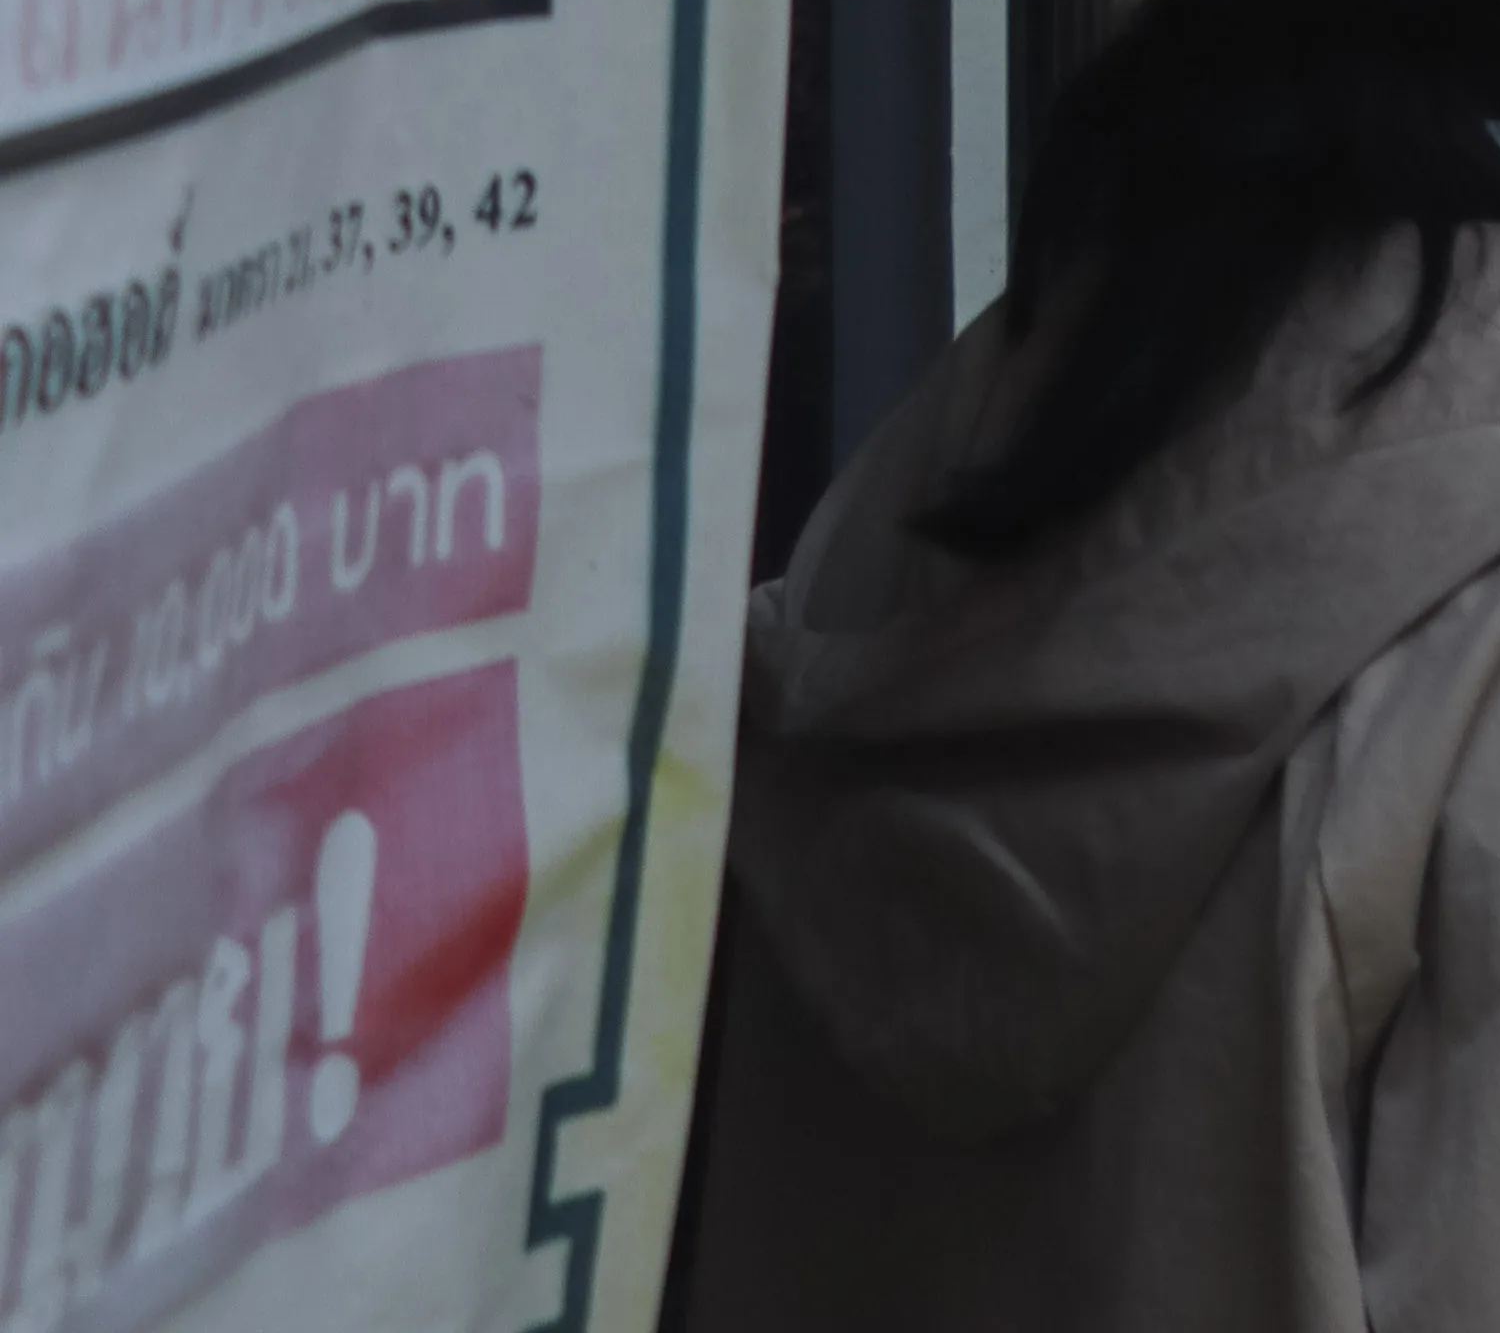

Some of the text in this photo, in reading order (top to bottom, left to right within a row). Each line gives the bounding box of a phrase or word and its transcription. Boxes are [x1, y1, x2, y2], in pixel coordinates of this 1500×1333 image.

[388, 183, 456, 258] 39,
[474, 167, 537, 230] 42
[330, 448, 507, 593] บาท
